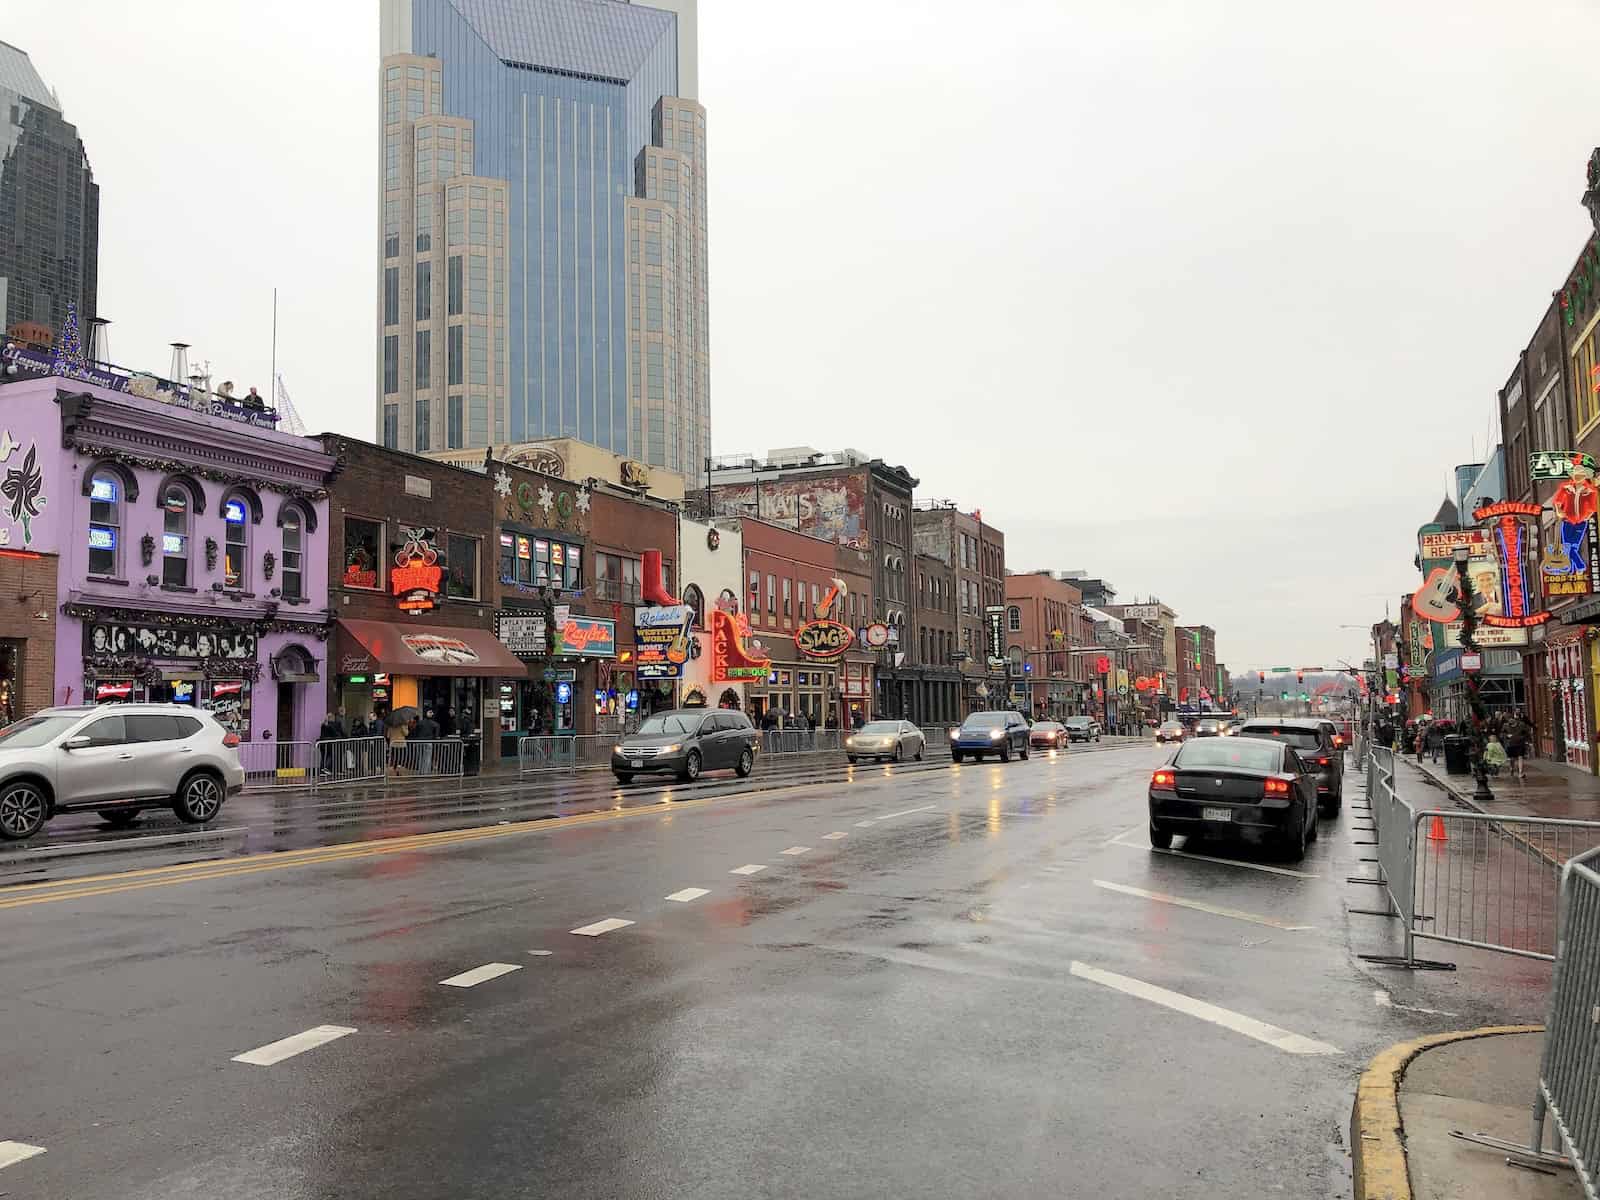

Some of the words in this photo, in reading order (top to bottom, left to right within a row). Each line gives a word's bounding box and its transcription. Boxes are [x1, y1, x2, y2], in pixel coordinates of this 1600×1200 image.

[1475, 502, 1542, 519] NASHVILLE
[1423, 531, 1473, 545] ERNEST
[1489, 618, 1521, 627] MUSIC
[1523, 613, 1548, 626] CITY
[637, 628, 680, 636] WESTERN
[643, 635, 674, 643] WORLD
[800, 628, 850, 650] STAGE
[715, 615, 729, 680] JACKS
